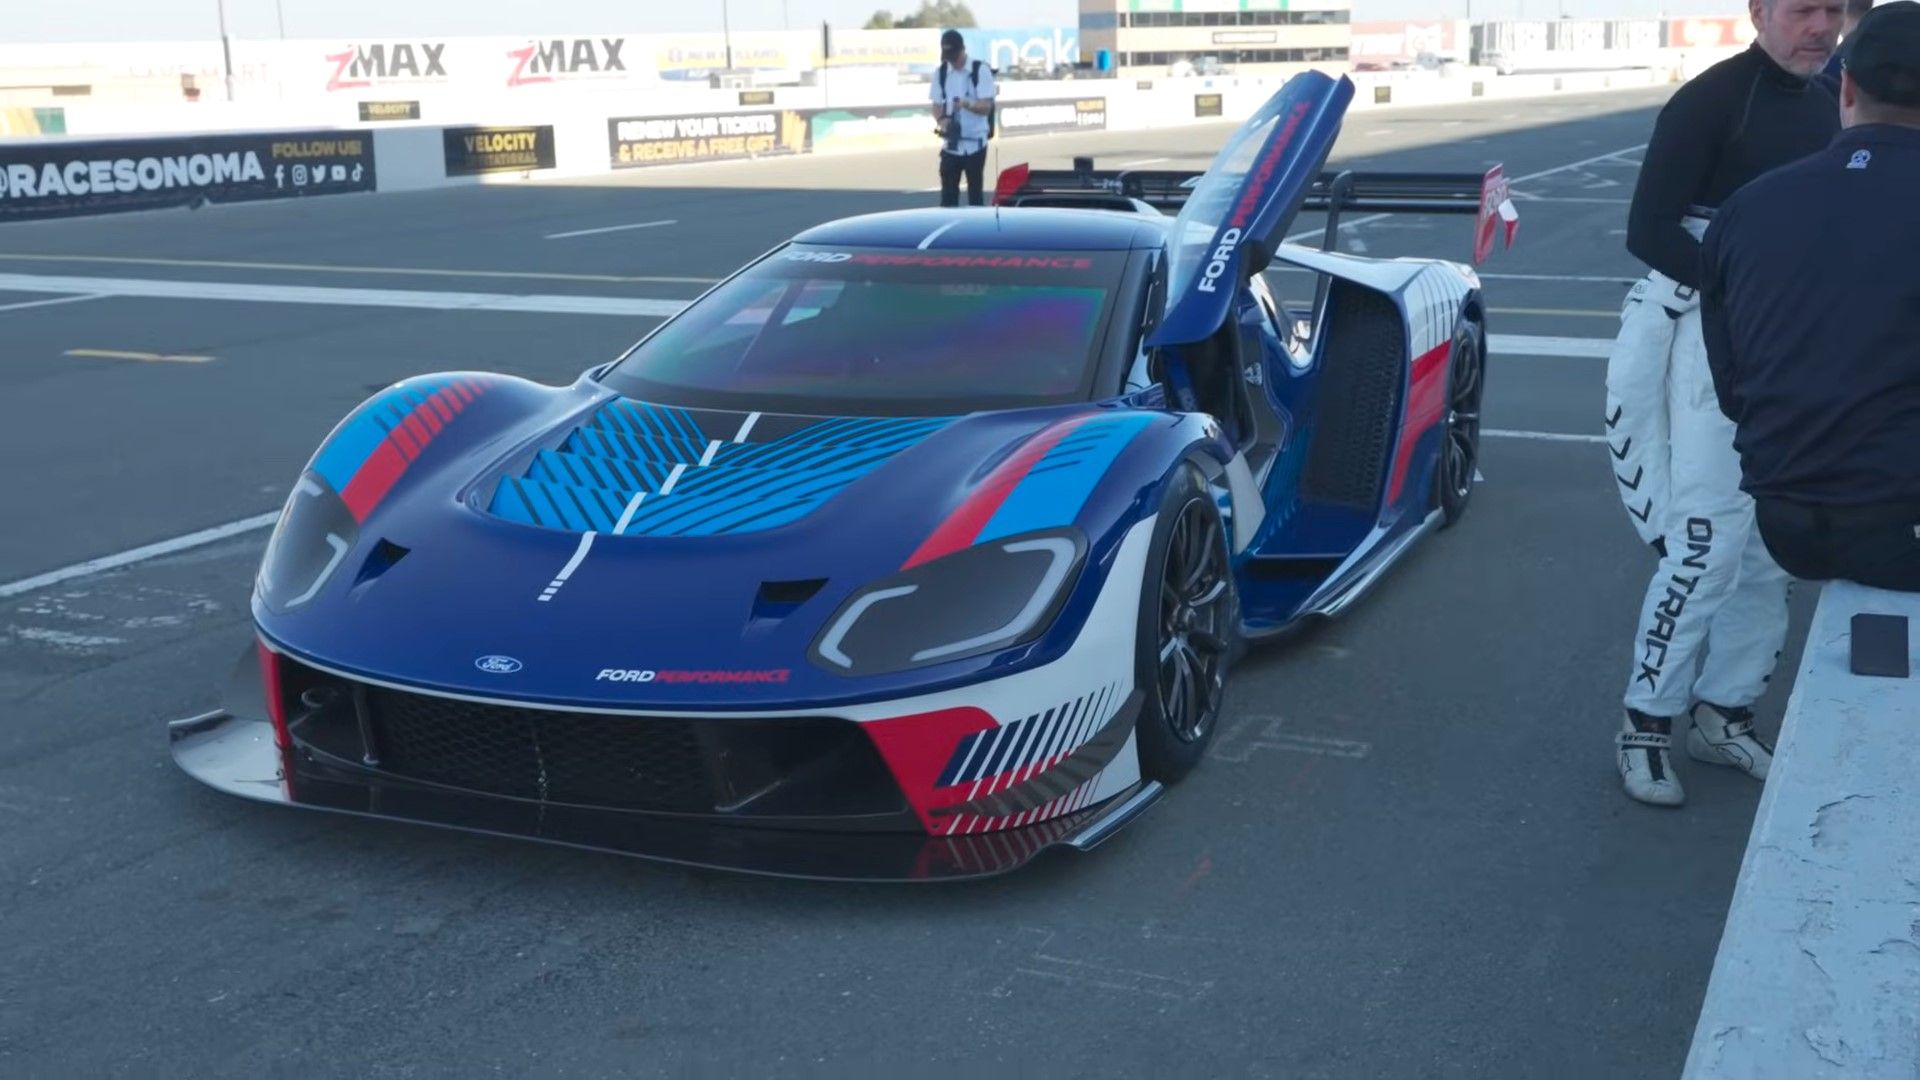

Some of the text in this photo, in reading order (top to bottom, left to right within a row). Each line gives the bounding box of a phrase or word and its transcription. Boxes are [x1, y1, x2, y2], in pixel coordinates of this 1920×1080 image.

[617, 114, 775, 140] RENEW YOUR TICKETS
[272, 141, 335, 158] FOLLOW
[464, 132, 536, 153] VELOCITY
[619, 135, 775, 162] & RECEIVE A FREE GIFT
[0, 150, 265, 198] RACESONOMA
[1198, 101, 1311, 292] FORD PERFORMANCE
[851, 254, 1093, 269] PERFORMANCE
[480, 656, 517, 672] Ford
[596, 668, 791, 683] FORD PERFORMANCE
